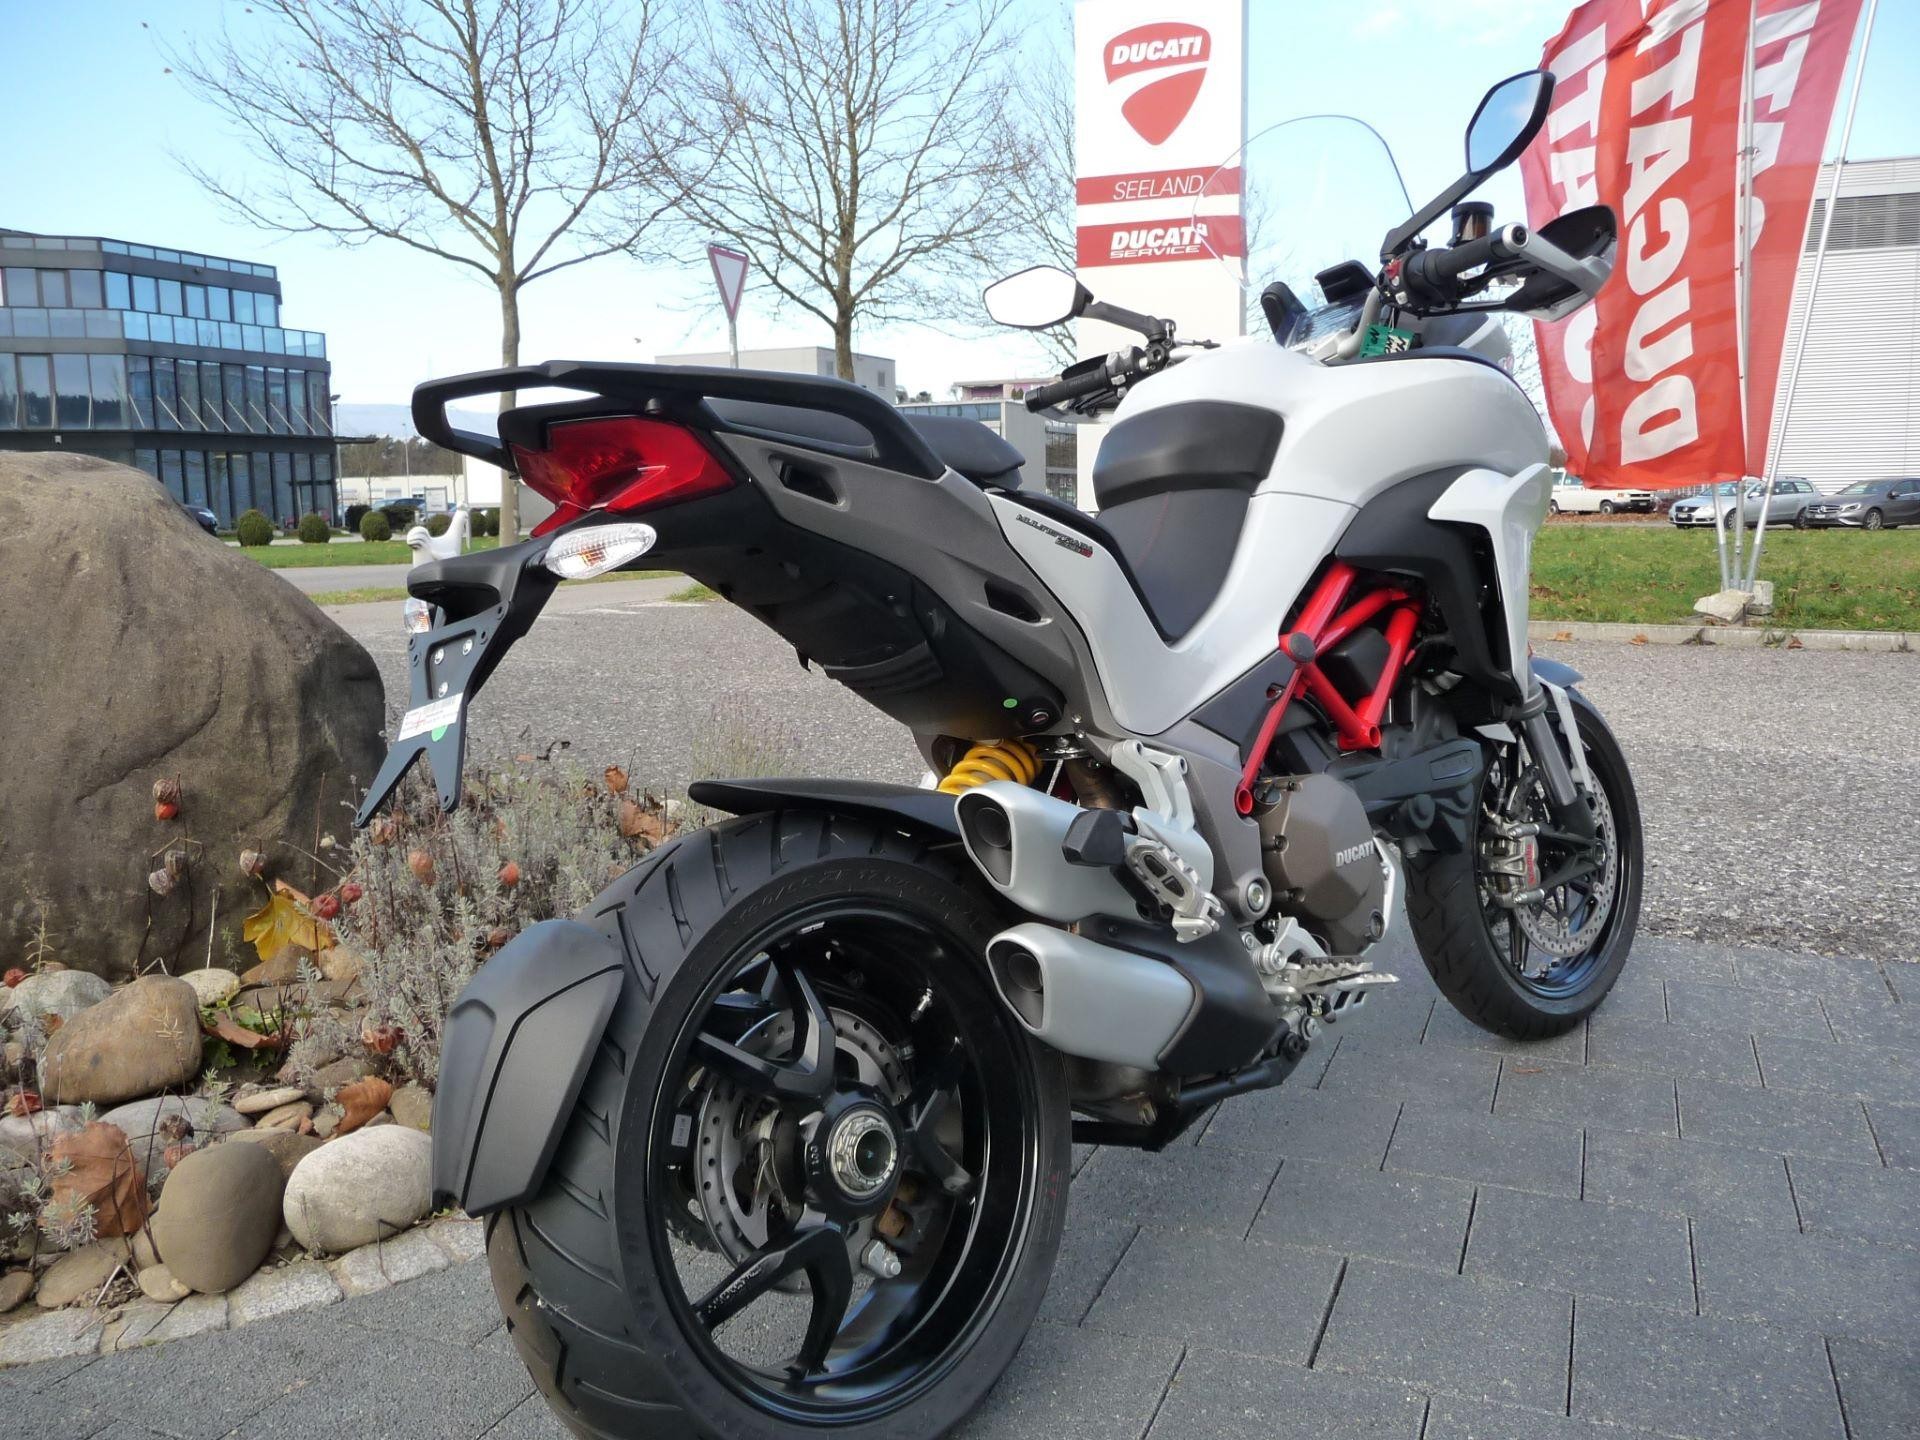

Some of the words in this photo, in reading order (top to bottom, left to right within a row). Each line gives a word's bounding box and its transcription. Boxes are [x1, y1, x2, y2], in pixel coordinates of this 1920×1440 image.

[1111, 35, 1203, 66] DUCATI
[1113, 174, 1204, 201] SEELAND
[1110, 223, 1207, 250] DUCATI
[1620, 0, 1708, 466] DUCATI
[1110, 244, 1200, 259] SERVICE
[1335, 840, 1375, 868] DUCATI
